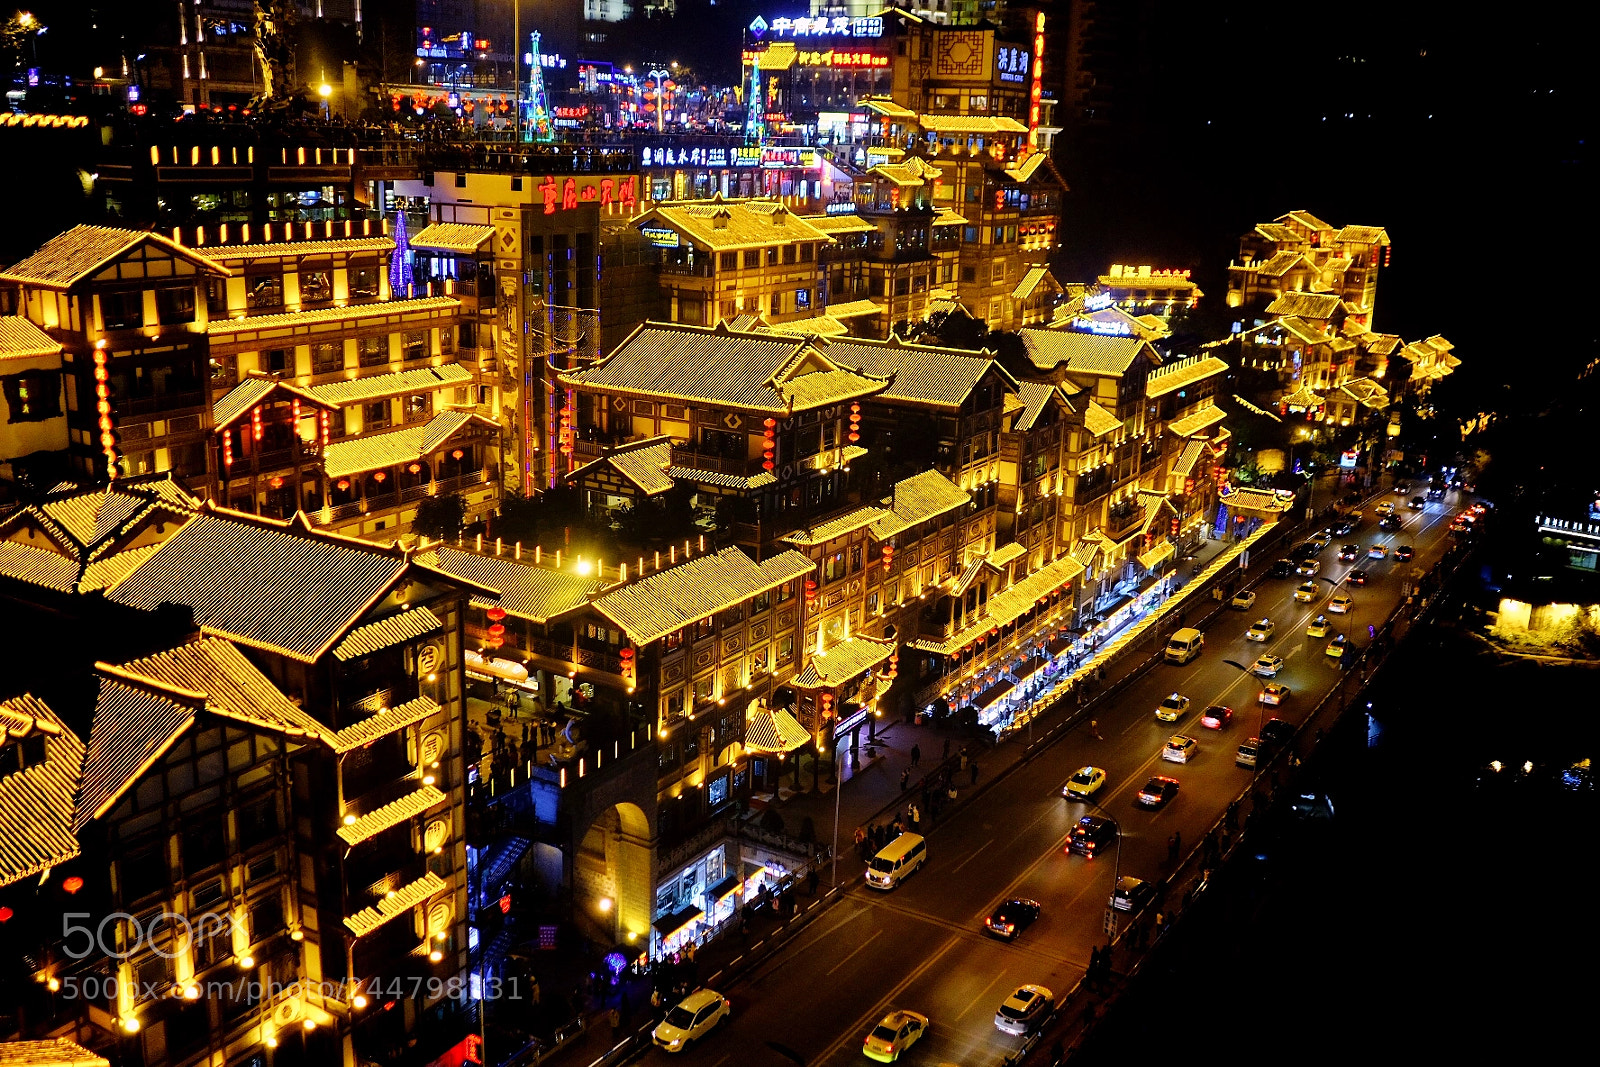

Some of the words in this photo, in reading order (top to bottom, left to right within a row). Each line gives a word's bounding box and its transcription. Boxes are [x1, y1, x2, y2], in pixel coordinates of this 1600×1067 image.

[998, 47, 1029, 74] 洪崖洞
[654, 147, 701, 166] 洞庭水岸
